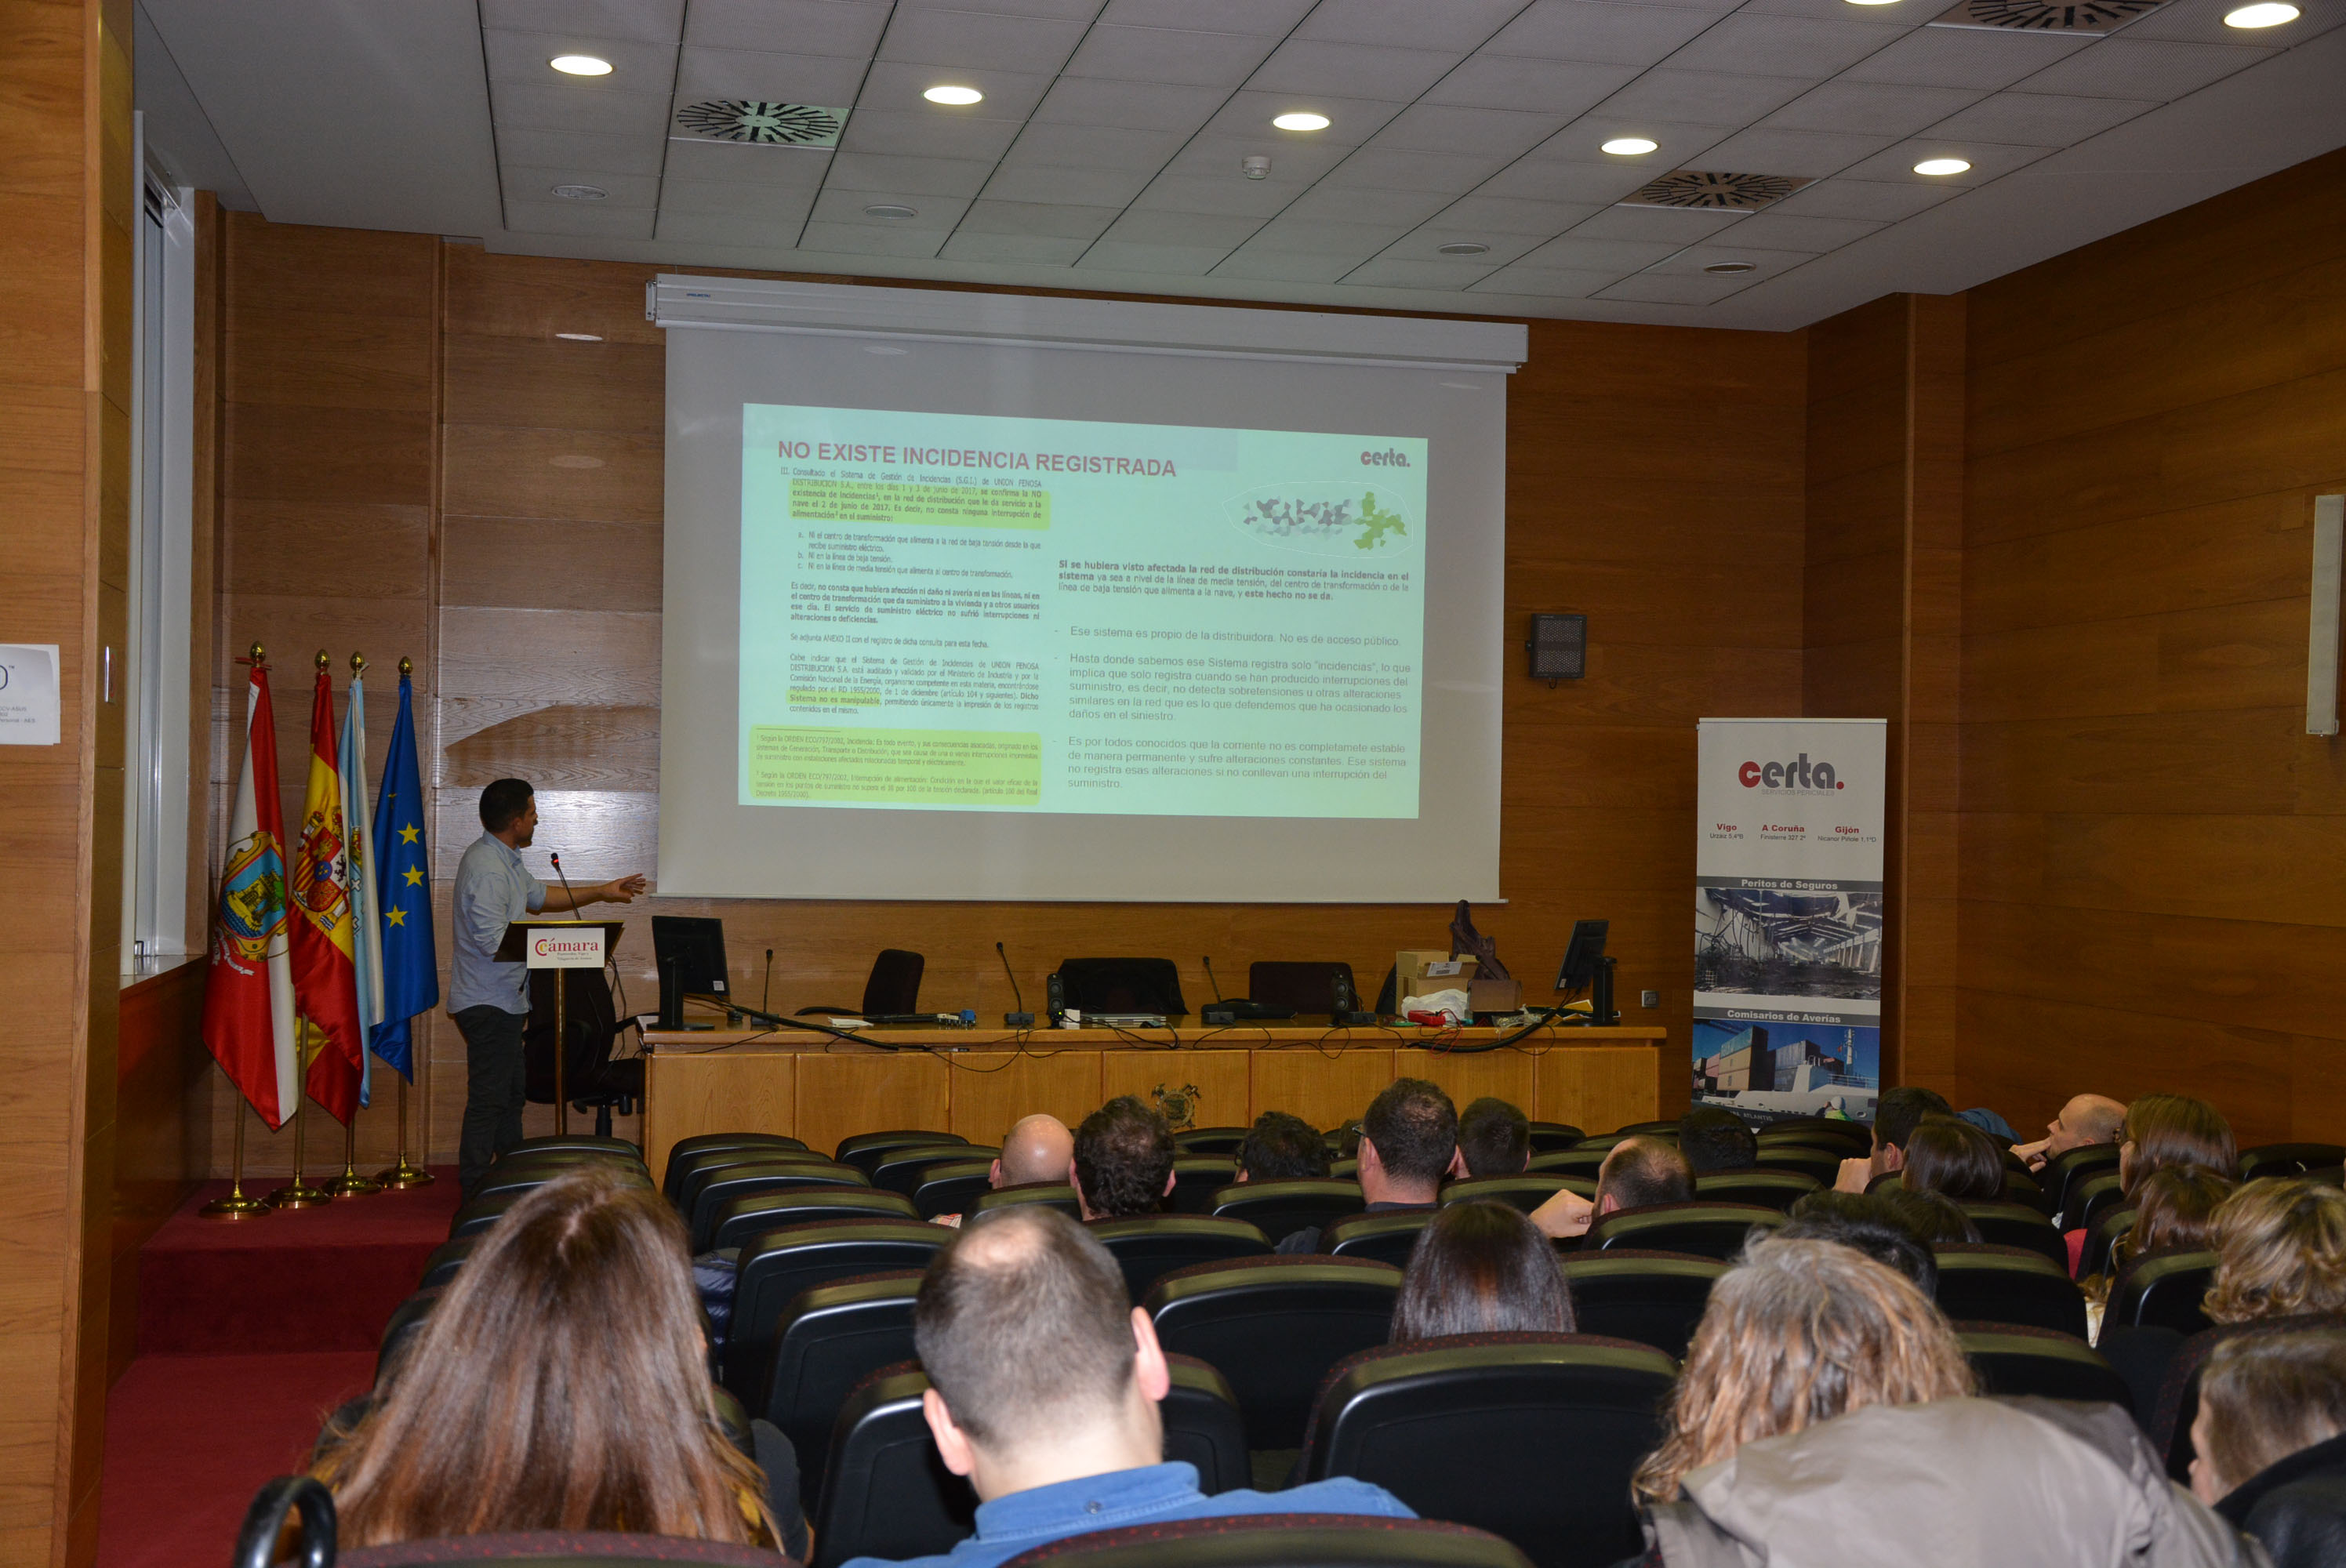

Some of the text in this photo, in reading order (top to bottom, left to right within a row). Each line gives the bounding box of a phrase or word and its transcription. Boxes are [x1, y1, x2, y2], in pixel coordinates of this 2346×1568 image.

[778, 441, 1176, 477] NO EXISTE INCIDENCIA REGISTRADA
[1360, 448, 1410, 467] certa.
[1059, 559, 1068, 568] Si
[1084, 561, 1120, 570] hubiera
[1148, 564, 1186, 573] afectada
[1232, 567, 1284, 576] distribución
[1287, 569, 1327, 578] constaría
[1341, 571, 1385, 579] incidencia
[1059, 583, 1077, 591] línea
[1093, 584, 1110, 594] baja
[1113, 585, 1142, 593] tensión
[1144, 586, 1159, 596] que
[1161, 586, 1195, 595] alimenta
[1204, 587, 1211, 596] la
[1237, 590, 1242, 600] y
[1266, 590, 1292, 599] hecho
[1070, 626, 1090, 636] Ese
[1094, 628, 1134, 637] sistema
[1151, 630, 1182, 641] propio
[1186, 630, 1198, 639] de
[1200, 631, 1210, 640] la
[1280, 633, 1294, 643] No
[1311, 635, 1324, 644] de
[1327, 636, 1361, 644] acceso
[1070, 654, 1099, 663] Hasta
[1103, 655, 1135, 664] donde
[1138, 656, 1183, 666] sabemos
[1208, 658, 1248, 668] Sistema
[1251, 660, 1288, 671] registra
[1291, 661, 1312, 670] solo
[1380, 663, 1390, 672] lo
[1393, 664, 1411, 674] que
[1070, 668, 1407, 688] implica que solo registra cuando se han producido interrupciones del
[1128, 684, 1140, 692] es
[1188, 685, 1226, 695] detecta
[1229, 687, 1304, 696] sobretensiones
[1314, 689, 1340, 698] otras
[1343, 690, 1401, 699] alteraciones
[1069, 709, 1100, 718] daños
[1069, 736, 1082, 746] Es
[1085, 739, 1101, 748] por
[1105, 739, 1132, 747] todos
[1135, 739, 1188, 749] conocidos
[1189, 741, 1208, 750] que
[1210, 740, 1219, 749] la
[1223, 741, 1266, 750] corriente
[1371, 744, 1405, 753] estable
[1068, 751, 1080, 760] de
[1084, 752, 1123, 760] manera
[1126, 753, 1186, 764] permanente
[1187, 754, 1196, 766] y
[1198, 754, 1223, 763] sufre
[1226, 755, 1285, 764] alteraciones
[1084, 765, 1122, 775] registra
[1152, 767, 1212, 776] alteraciones
[1313, 770, 1370, 780] interrupción
[1738, 753, 1844, 789] certa.
[1716, 823, 1737, 832] Vigo
[1741, 879, 1777, 887] Peritos
[1796, 881, 1838, 891] Seguros
[536, 938, 598, 956] Cámara
[1727, 1009, 1784, 1020] Comisarios
[1802, 1014, 1841, 1023] Averías
